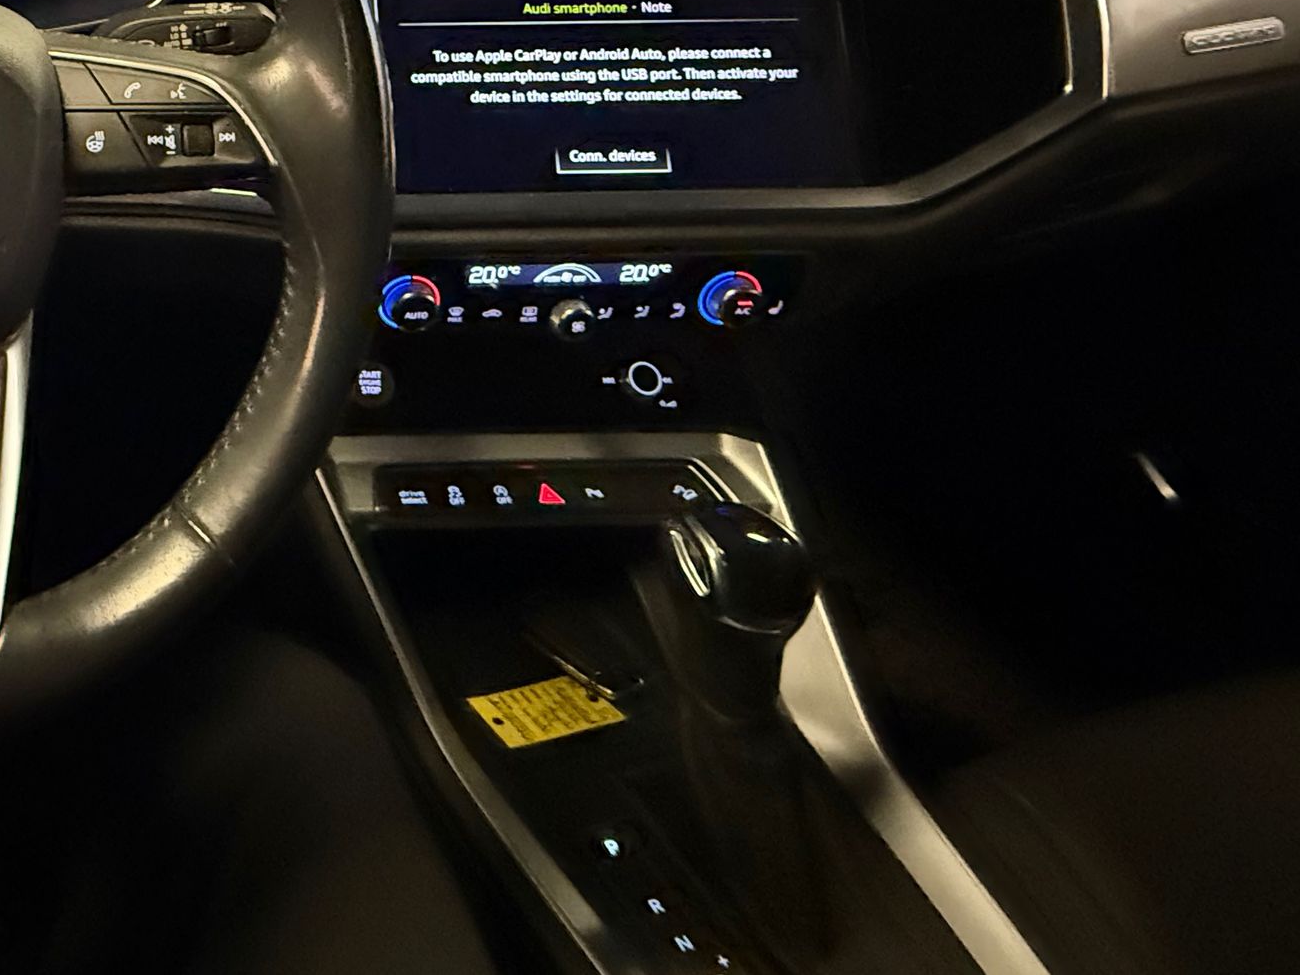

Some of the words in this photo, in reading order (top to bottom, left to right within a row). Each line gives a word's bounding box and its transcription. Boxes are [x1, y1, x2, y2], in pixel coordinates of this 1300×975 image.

[523, 3, 551, 14] Audi
[553, 2, 628, 16] smartphone
[641, 1, 672, 13] Note
[432, 49, 450, 62] To
[451, 51, 474, 62] use
[475, 49, 513, 64] Apple
[514, 49, 561, 64] CarPlay
[563, 50, 578, 61] or
[579, 48, 629, 61] Android
[631, 48, 666, 61] Auto,
[668, 47, 709, 62] please
[710, 47, 761, 59] connect
[762, 49, 772, 58] a
[410, 71, 481, 85] compatible
[483, 69, 560, 84] smartphone
[562, 69, 597, 83] using
[598, 68, 620, 81] the
[621, 68, 648, 80] USB
[650, 68, 682, 82] port.
[683, 68, 715, 80] Then
[717, 67, 767, 79] activate
[769, 68, 799, 81] your
[470, 90, 511, 103] device
[512, 90, 526, 102] in
[527, 90, 549, 102] the
[550, 89, 601, 104] settings
[603, 88, 623, 101] for
[625, 88, 690, 101] connected
[692, 87, 742, 100] devices.
[569, 149, 607, 162] Conn.
[608, 148, 656, 162] devices
[404, 311, 429, 320] AUTO
[360, 386, 382, 395] STOP
[648, 899, 666, 914] R
[674, 935, 696, 953] N
